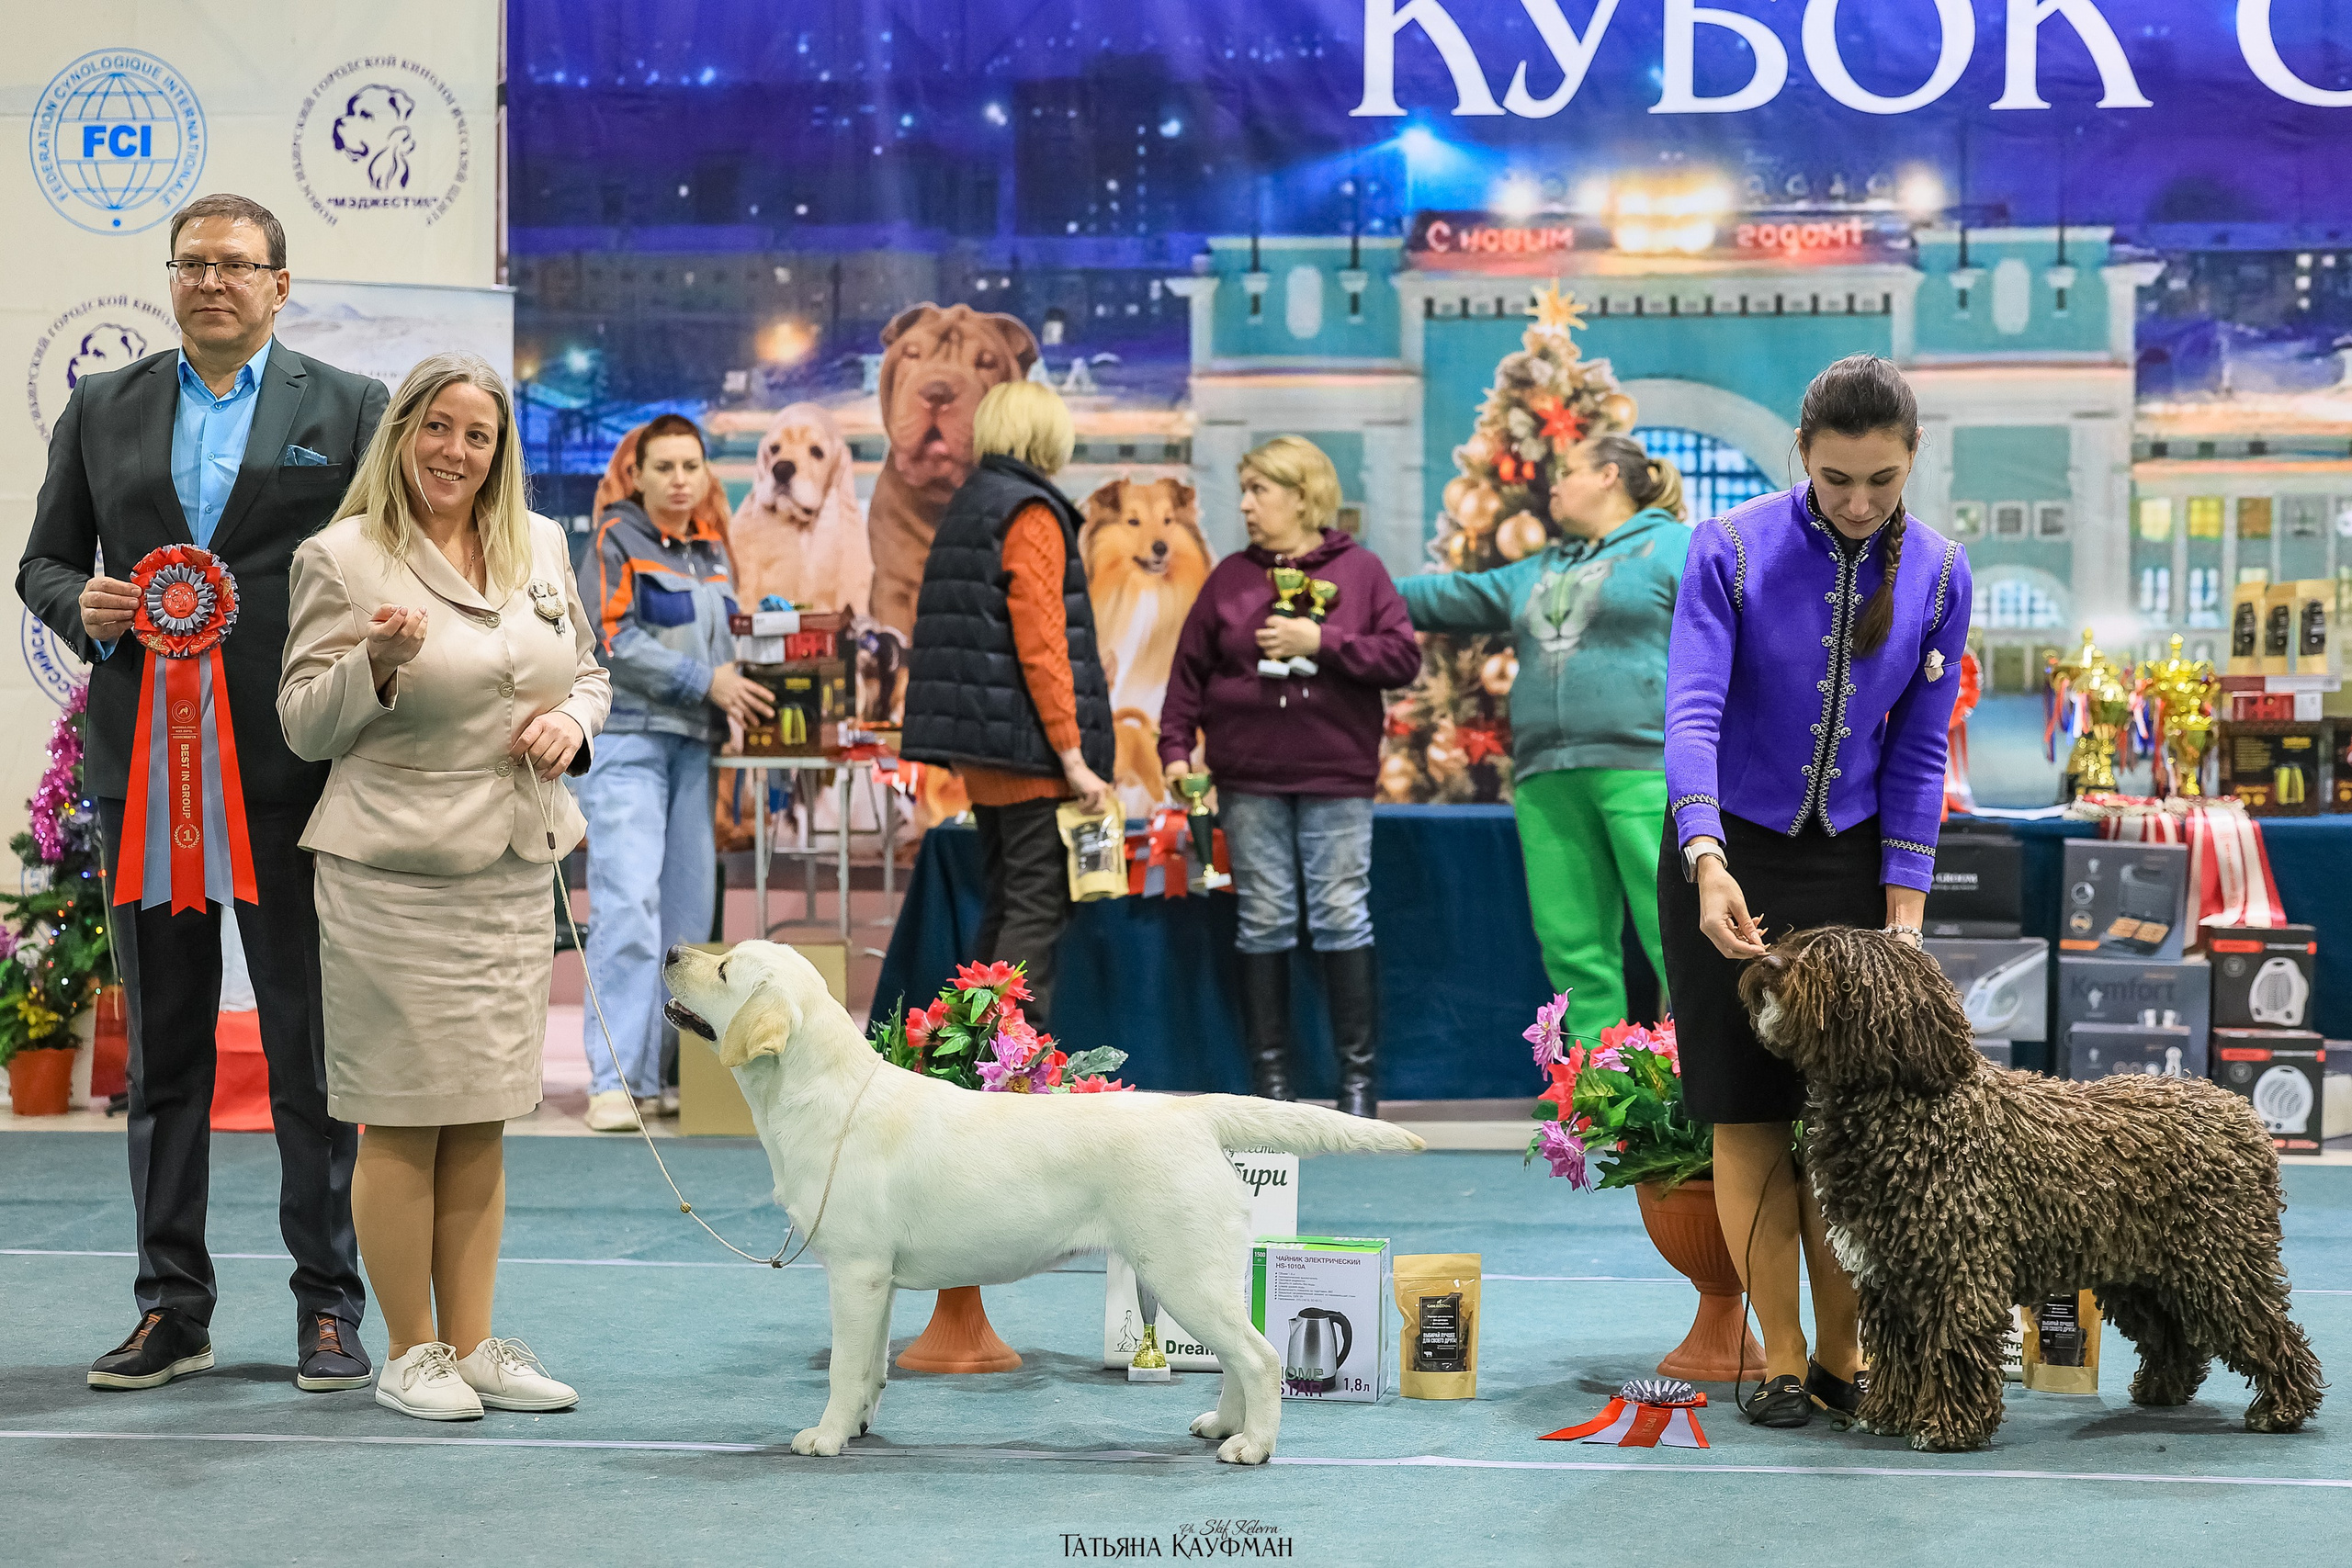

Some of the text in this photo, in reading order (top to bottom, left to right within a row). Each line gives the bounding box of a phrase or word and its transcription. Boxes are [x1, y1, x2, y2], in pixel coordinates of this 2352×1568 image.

[312, 53, 397, 97] ГОРОДСКОЙ
[39, 55, 199, 208] FEDERATION CYNOLOGIQUE INTERNATIONALE
[83, 125, 152, 158] FCI
[180, 744, 190, 769] BEST
[181, 771, 190, 782] IN
[181, 784, 191, 819] GROUP
[183, 829, 193, 841] 1
[1275, 1255, 1362, 1266] ЧАЙНИК ЭЛЕКТРИЧЕСКИЙ
[1281, 1366, 1324, 1382] OME
